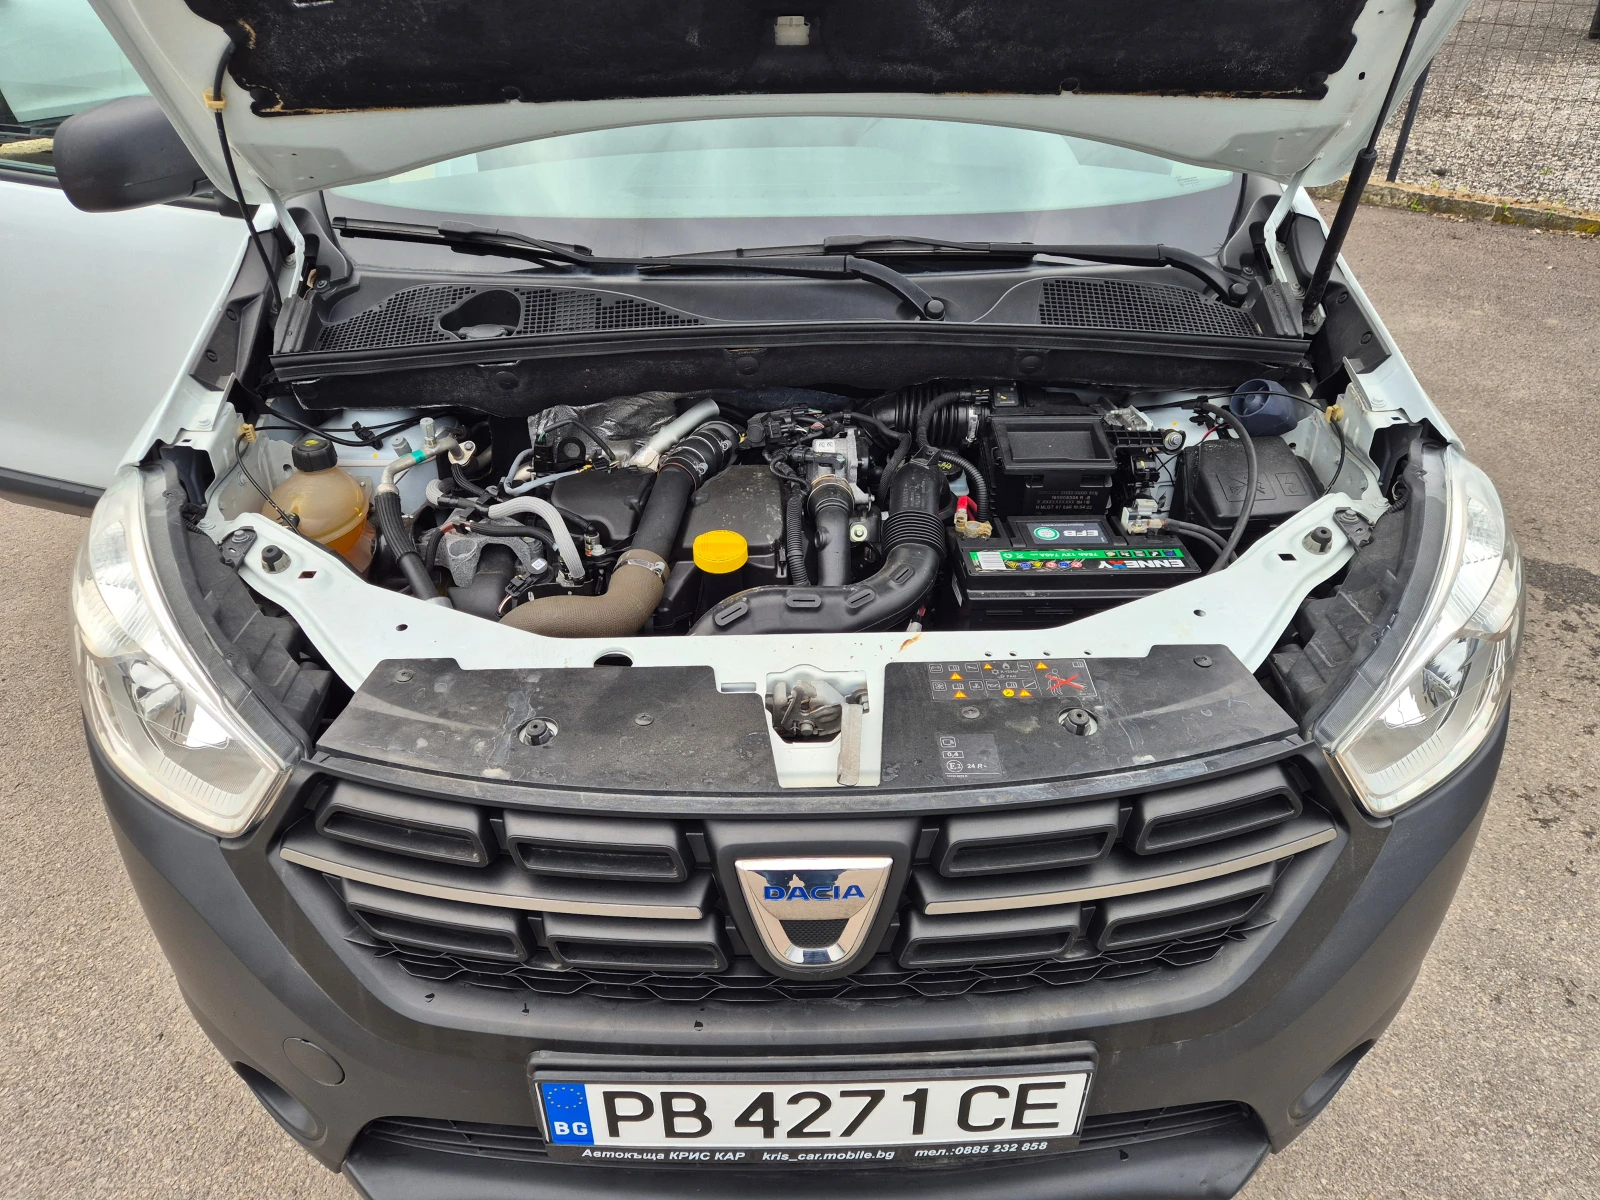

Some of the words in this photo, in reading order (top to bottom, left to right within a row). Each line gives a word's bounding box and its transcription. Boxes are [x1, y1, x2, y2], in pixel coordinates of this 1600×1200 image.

[1063, 529, 1099, 537] EFB
[1098, 559, 1186, 570] ENNEXY
[763, 884, 866, 902] DACIA
[553, 1121, 588, 1136] BG
[602, 1090, 713, 1138] PB
[734, 1088, 929, 1138] 4271
[957, 1081, 1067, 1132] CE
[581, 1148, 665, 1160] Автокъща
[669, 1151, 711, 1160] КРИС
[714, 1151, 746, 1161] КАР
[762, 1150, 896, 1162] kris_car.mobile.bg
[992, 1143, 1019, 1153] 232
[1021, 1141, 1049, 1151] 858
